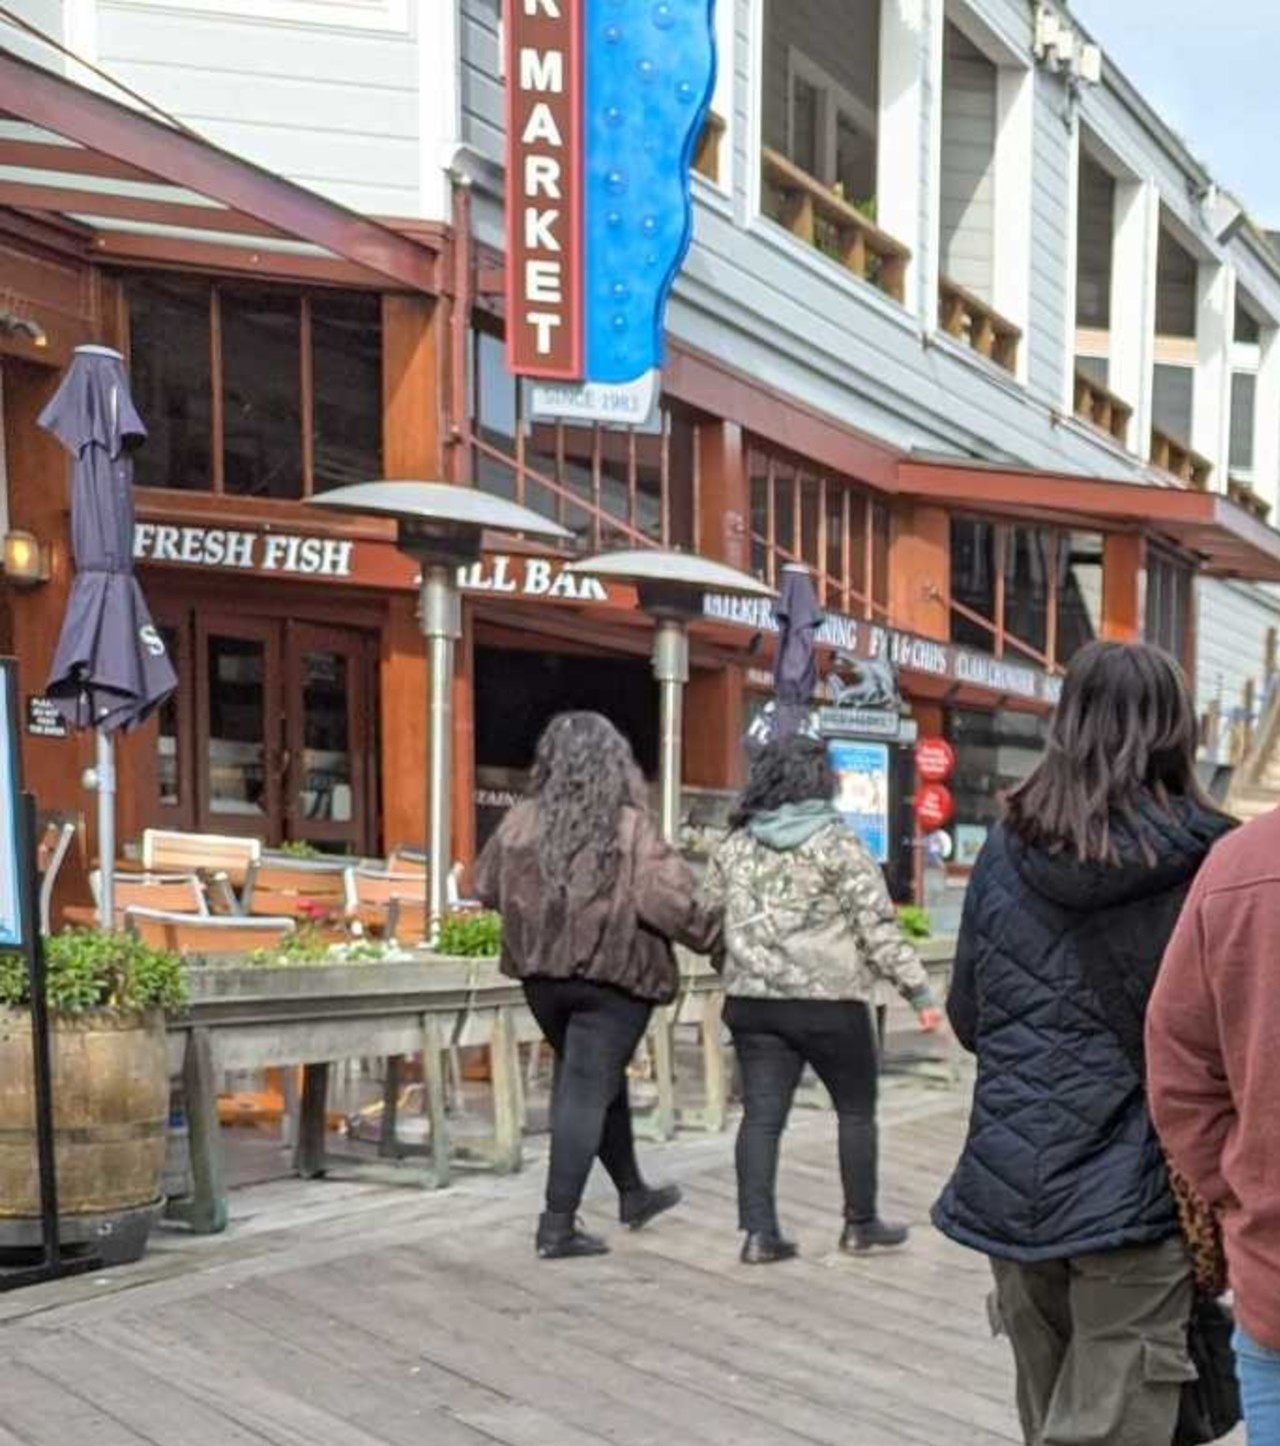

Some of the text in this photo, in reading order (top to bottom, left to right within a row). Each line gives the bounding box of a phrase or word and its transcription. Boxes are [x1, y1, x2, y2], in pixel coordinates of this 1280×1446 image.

[518, 48, 564, 357] MARKET
[133, 524, 353, 576] FRESH FISH
